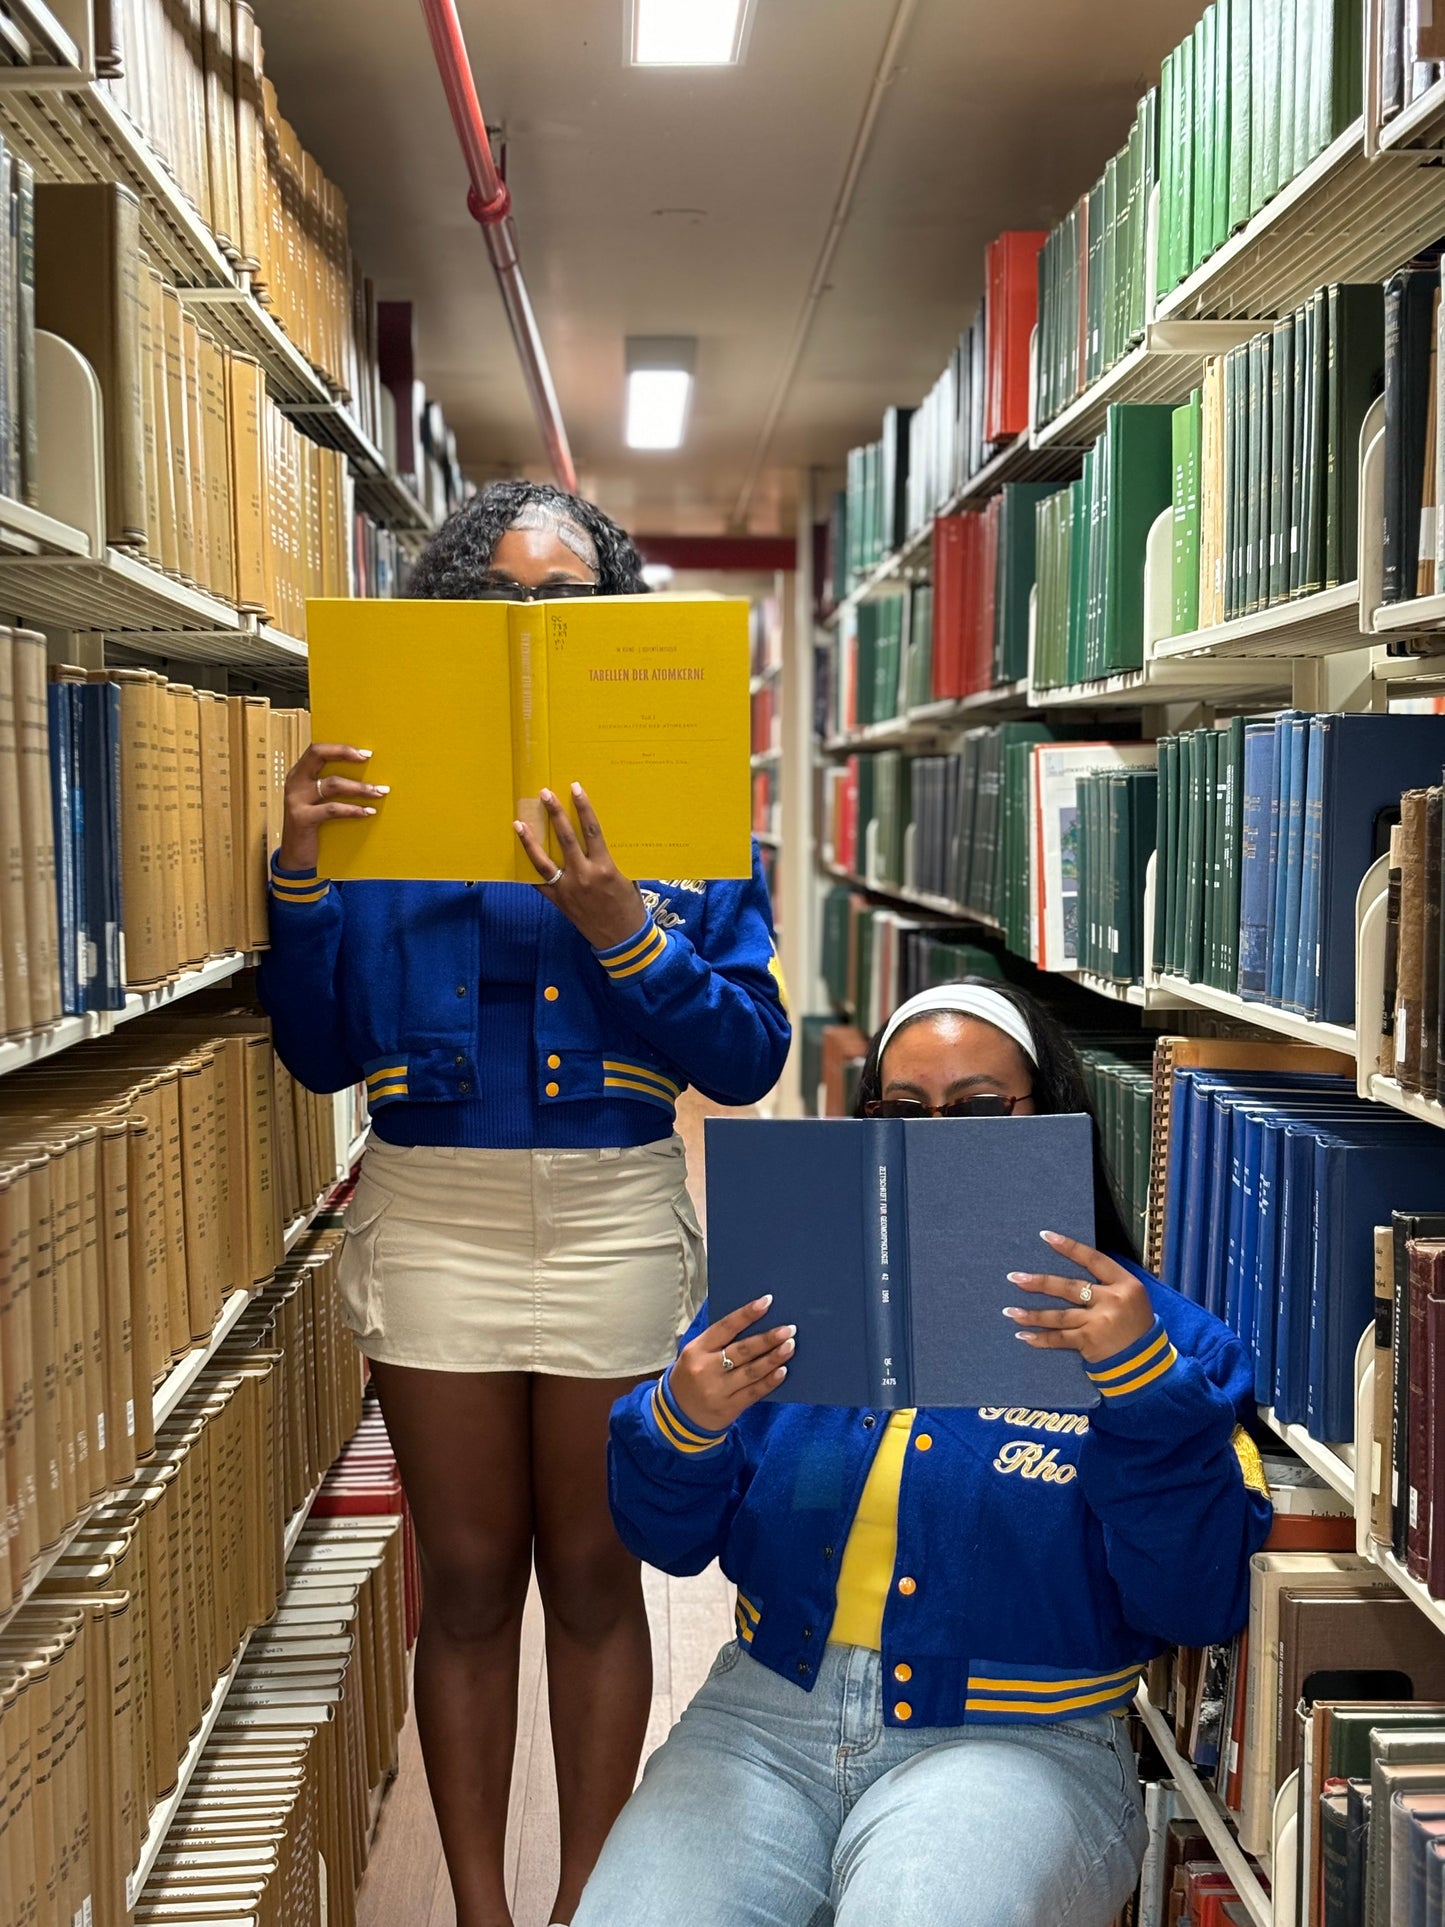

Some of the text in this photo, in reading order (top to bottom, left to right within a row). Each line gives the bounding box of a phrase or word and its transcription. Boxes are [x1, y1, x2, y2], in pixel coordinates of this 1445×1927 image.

[588, 668, 705, 682] TABELLEN DER ATOMKERNE
[878, 1165, 888, 1202] ZEITSCHRIFT
[880, 1215, 889, 1265] GEOMORPHOLOGIE
[992, 1440, 1078, 1484] Rho
